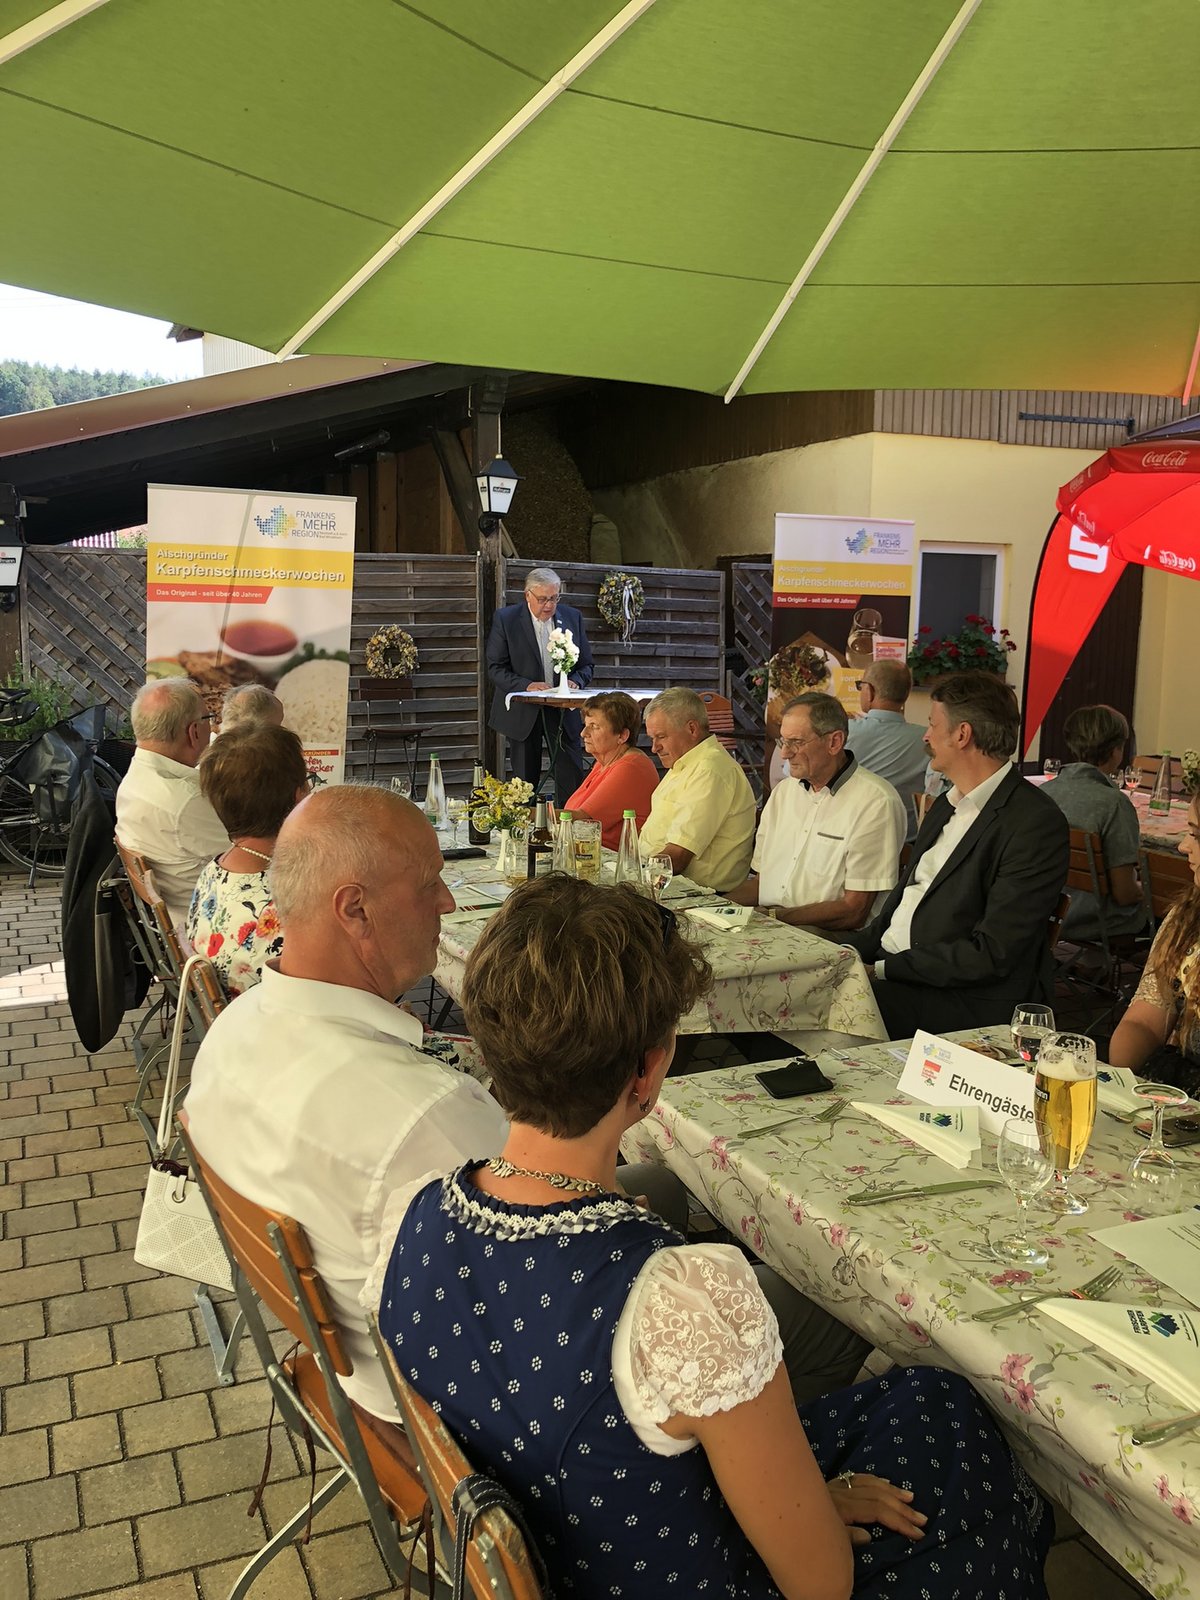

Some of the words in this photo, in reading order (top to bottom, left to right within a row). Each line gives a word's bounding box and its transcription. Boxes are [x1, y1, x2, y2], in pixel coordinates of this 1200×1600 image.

[1142, 450, 1191, 467] Coca-Cola
[295, 510, 336, 520] FRANKENS
[303, 519, 336, 531] MEHR
[291, 529, 320, 538] REGION
[877, 539, 901, 548] MEHR
[156, 549, 229, 561] Aischgründer
[155, 562, 346, 582] Karpfenschmeckerwochen
[170, 590, 197, 598] Original
[787, 596, 808, 604] Original
[949, 1074, 1035, 1124] Ehrengäste
